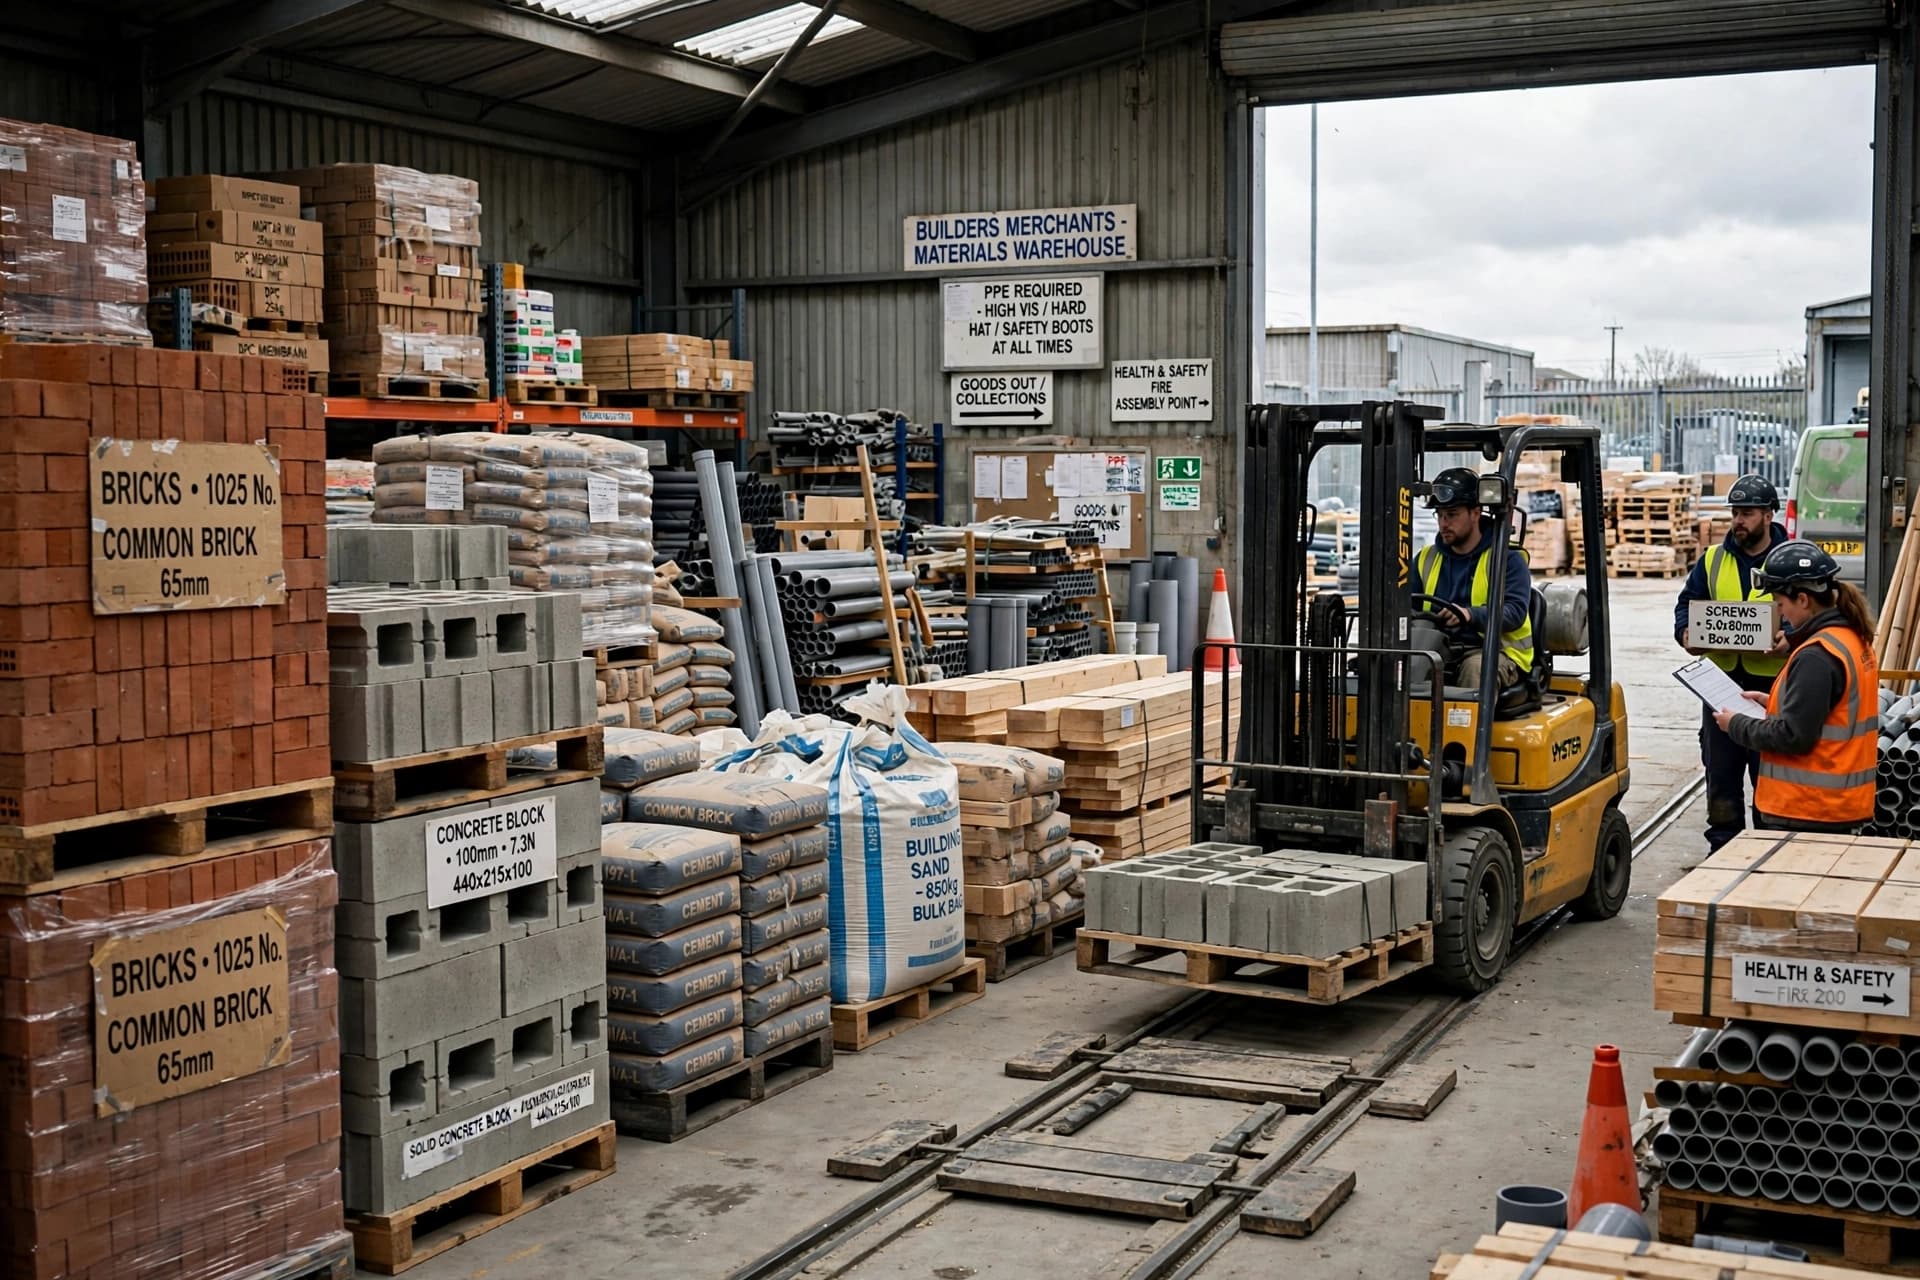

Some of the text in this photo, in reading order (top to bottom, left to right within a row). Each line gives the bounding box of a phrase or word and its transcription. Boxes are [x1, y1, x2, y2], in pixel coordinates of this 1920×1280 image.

[916, 217, 999, 240] BUILDERS
[1006, 211, 1116, 236] MERCHANTS
[914, 236, 1126, 265] MATERIALS WAREHOUSE
[984, 282, 1082, 299] PPE REQUIRED
[985, 303, 1016, 318] HIGH
[1020, 302, 1039, 316] VIS
[1043, 302, 1048, 316] /
[1052, 300, 1086, 315] HARD
[969, 319, 1094, 336] HAT / SAFETY BOOTS
[238, 344, 256, 355] DPC
[992, 339, 1073, 354] AT ALL TIMES
[960, 377, 1046, 390] GOODS OUT /
[1114, 364, 1208, 378] HEALTH & SAFETY
[956, 392, 1046, 405] COLLECTIONS
[1151, 381, 1172, 393] FIRE
[1116, 396, 1198, 410] ASSEMBLY POINT
[102, 471, 182, 505] BRICKS
[206, 473, 247, 506] 1025
[253, 474, 277, 506] No.
[1074, 504, 1106, 516] GOODS
[103, 526, 258, 560] COMMON BRICK
[160, 568, 209, 597] 65mm
[1705, 606, 1757, 618] SCREWS
[1708, 633, 1730, 645] Box
[1734, 634, 1754, 645] 200
[436, 804, 545, 845] CONCRETE BLOCK
[644, 803, 735, 825] COMMON BRICK
[456, 844, 498, 867] 100mm
[510, 832, 536, 855] 7.3N
[906, 828, 960, 858] BUILDING
[453, 859, 533, 893] 440x215x100
[682, 851, 726, 878] CEMENT
[911, 857, 950, 879] SAND
[682, 891, 725, 919] CEMENT
[913, 901, 946, 921] BULK
[683, 930, 724, 957] CEMENT
[112, 947, 196, 998] BRICKS
[214, 936, 254, 975] 1025
[259, 932, 282, 965] No.
[1745, 961, 1895, 988] HEALTH & SAFETY
[684, 969, 727, 997] CEMENT
[1815, 988, 1846, 1006] 200
[108, 984, 273, 1054] COMMON BRICK
[684, 1008, 727, 1036] CEMENT
[157, 1050, 214, 1084] 65mm
[685, 1046, 727, 1075] CEMENT
[409, 1138, 437, 1159] SOLID
[438, 1120, 484, 1147] CONCRETE
[486, 1107, 512, 1129] BLOCK
